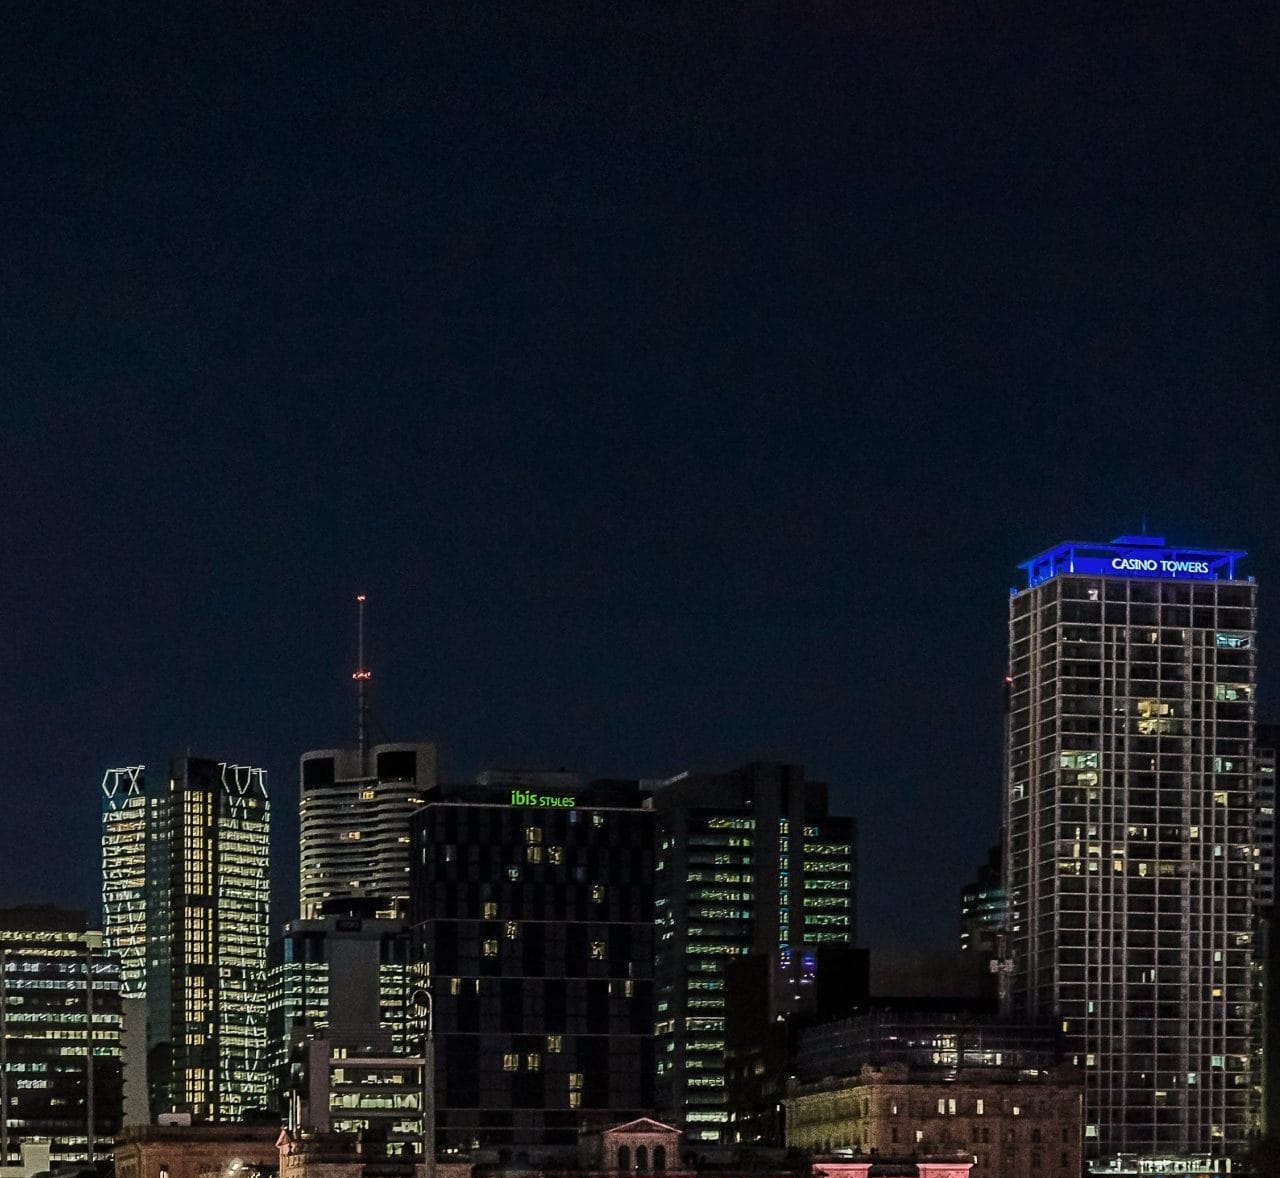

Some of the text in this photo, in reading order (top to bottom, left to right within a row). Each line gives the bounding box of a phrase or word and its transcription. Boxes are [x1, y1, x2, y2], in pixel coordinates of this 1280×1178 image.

[1112, 558, 1209, 573] CASINO TOWERS
[511, 790, 538, 805] ibis
